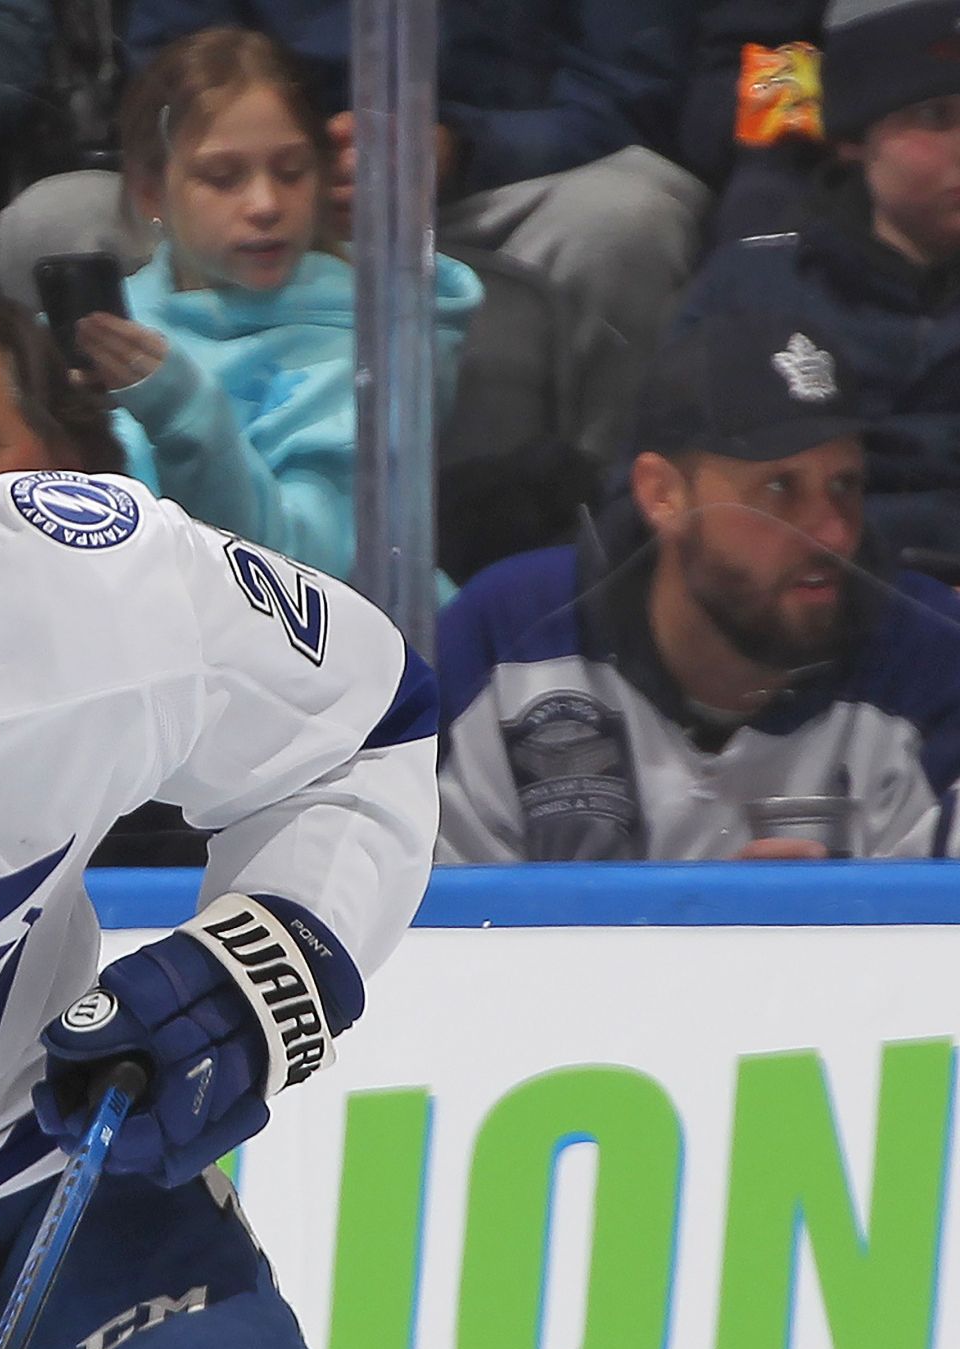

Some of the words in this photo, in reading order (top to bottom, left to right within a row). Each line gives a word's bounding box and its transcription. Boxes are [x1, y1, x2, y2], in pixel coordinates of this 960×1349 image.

[23, 508, 58, 534] BAY
[63, 525, 128, 546] TAMPA
[222, 536, 329, 668] 2
[290, 919, 333, 957] POINT
